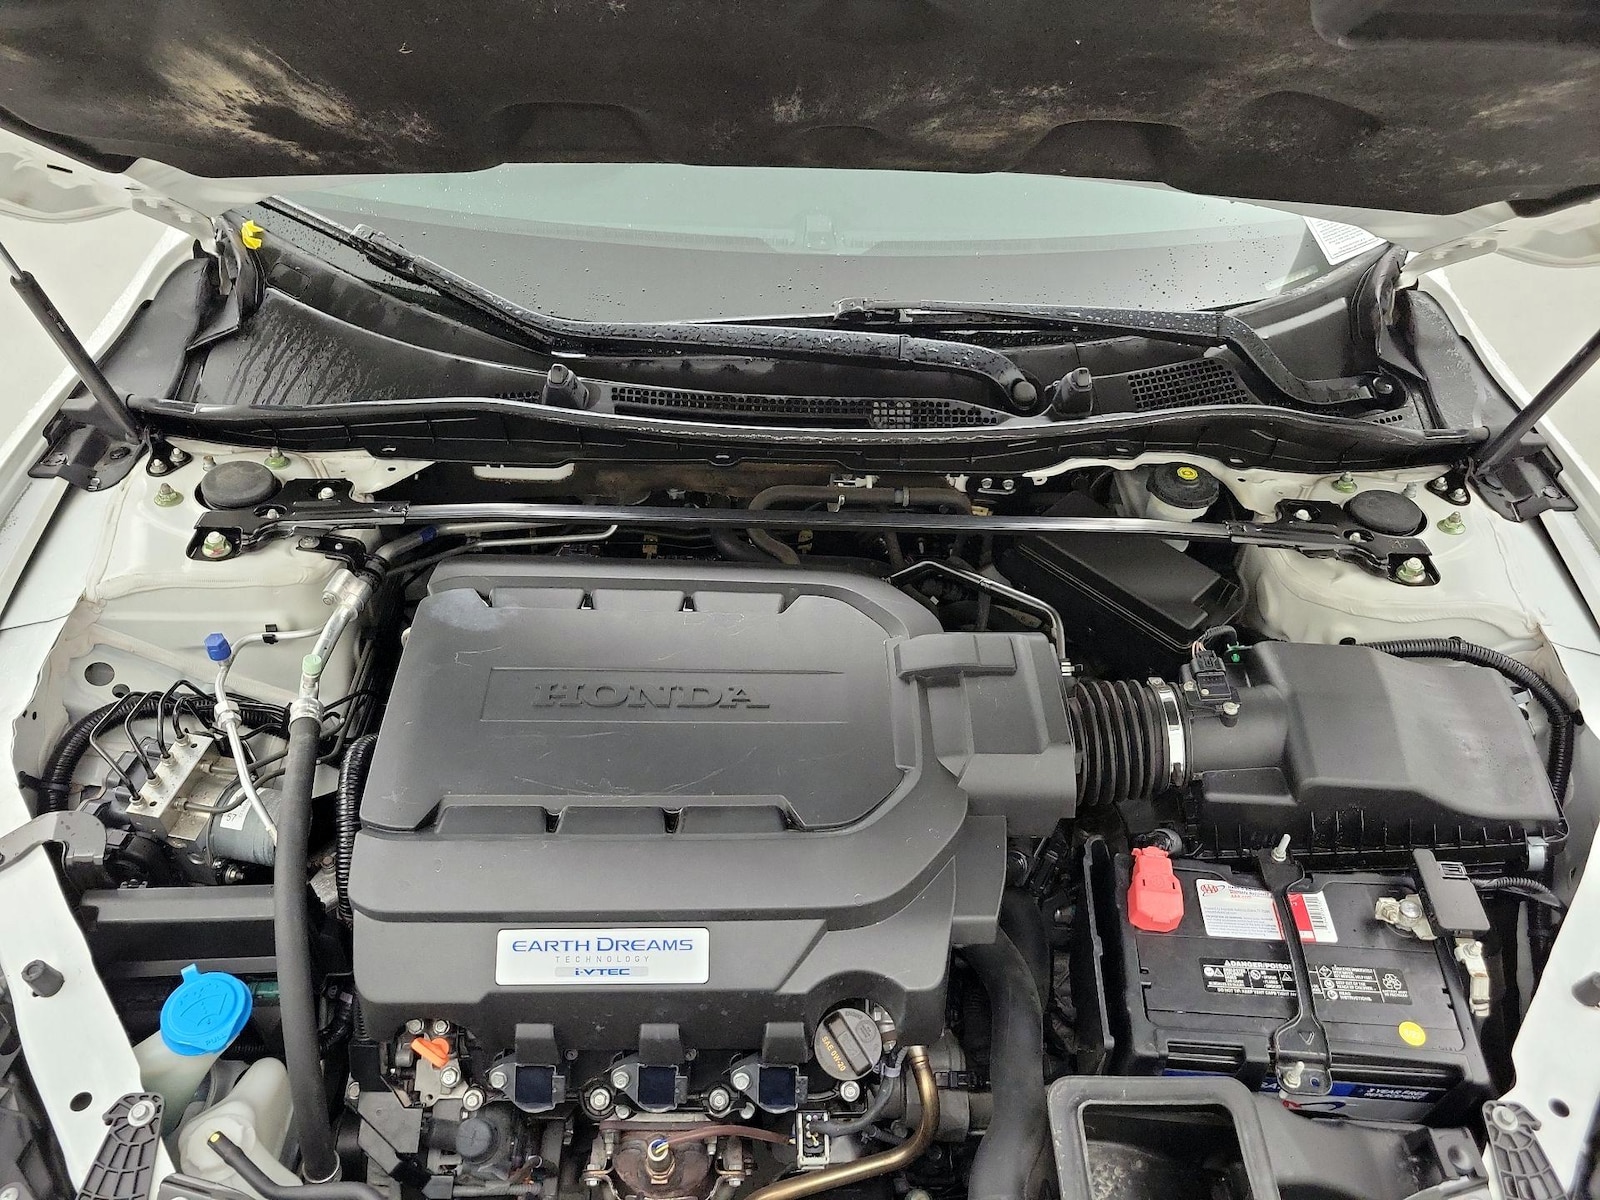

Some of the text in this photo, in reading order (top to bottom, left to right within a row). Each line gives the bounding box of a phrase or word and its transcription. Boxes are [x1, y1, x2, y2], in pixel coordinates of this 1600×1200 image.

[532, 684, 770, 709] HONDA
[511, 937, 694, 952] EARTH DREAMS
[555, 955, 650, 964] TECHNOLOGY
[575, 967, 631, 976] i-VTEC
[822, 1036, 846, 1072] SAE 0W-20
